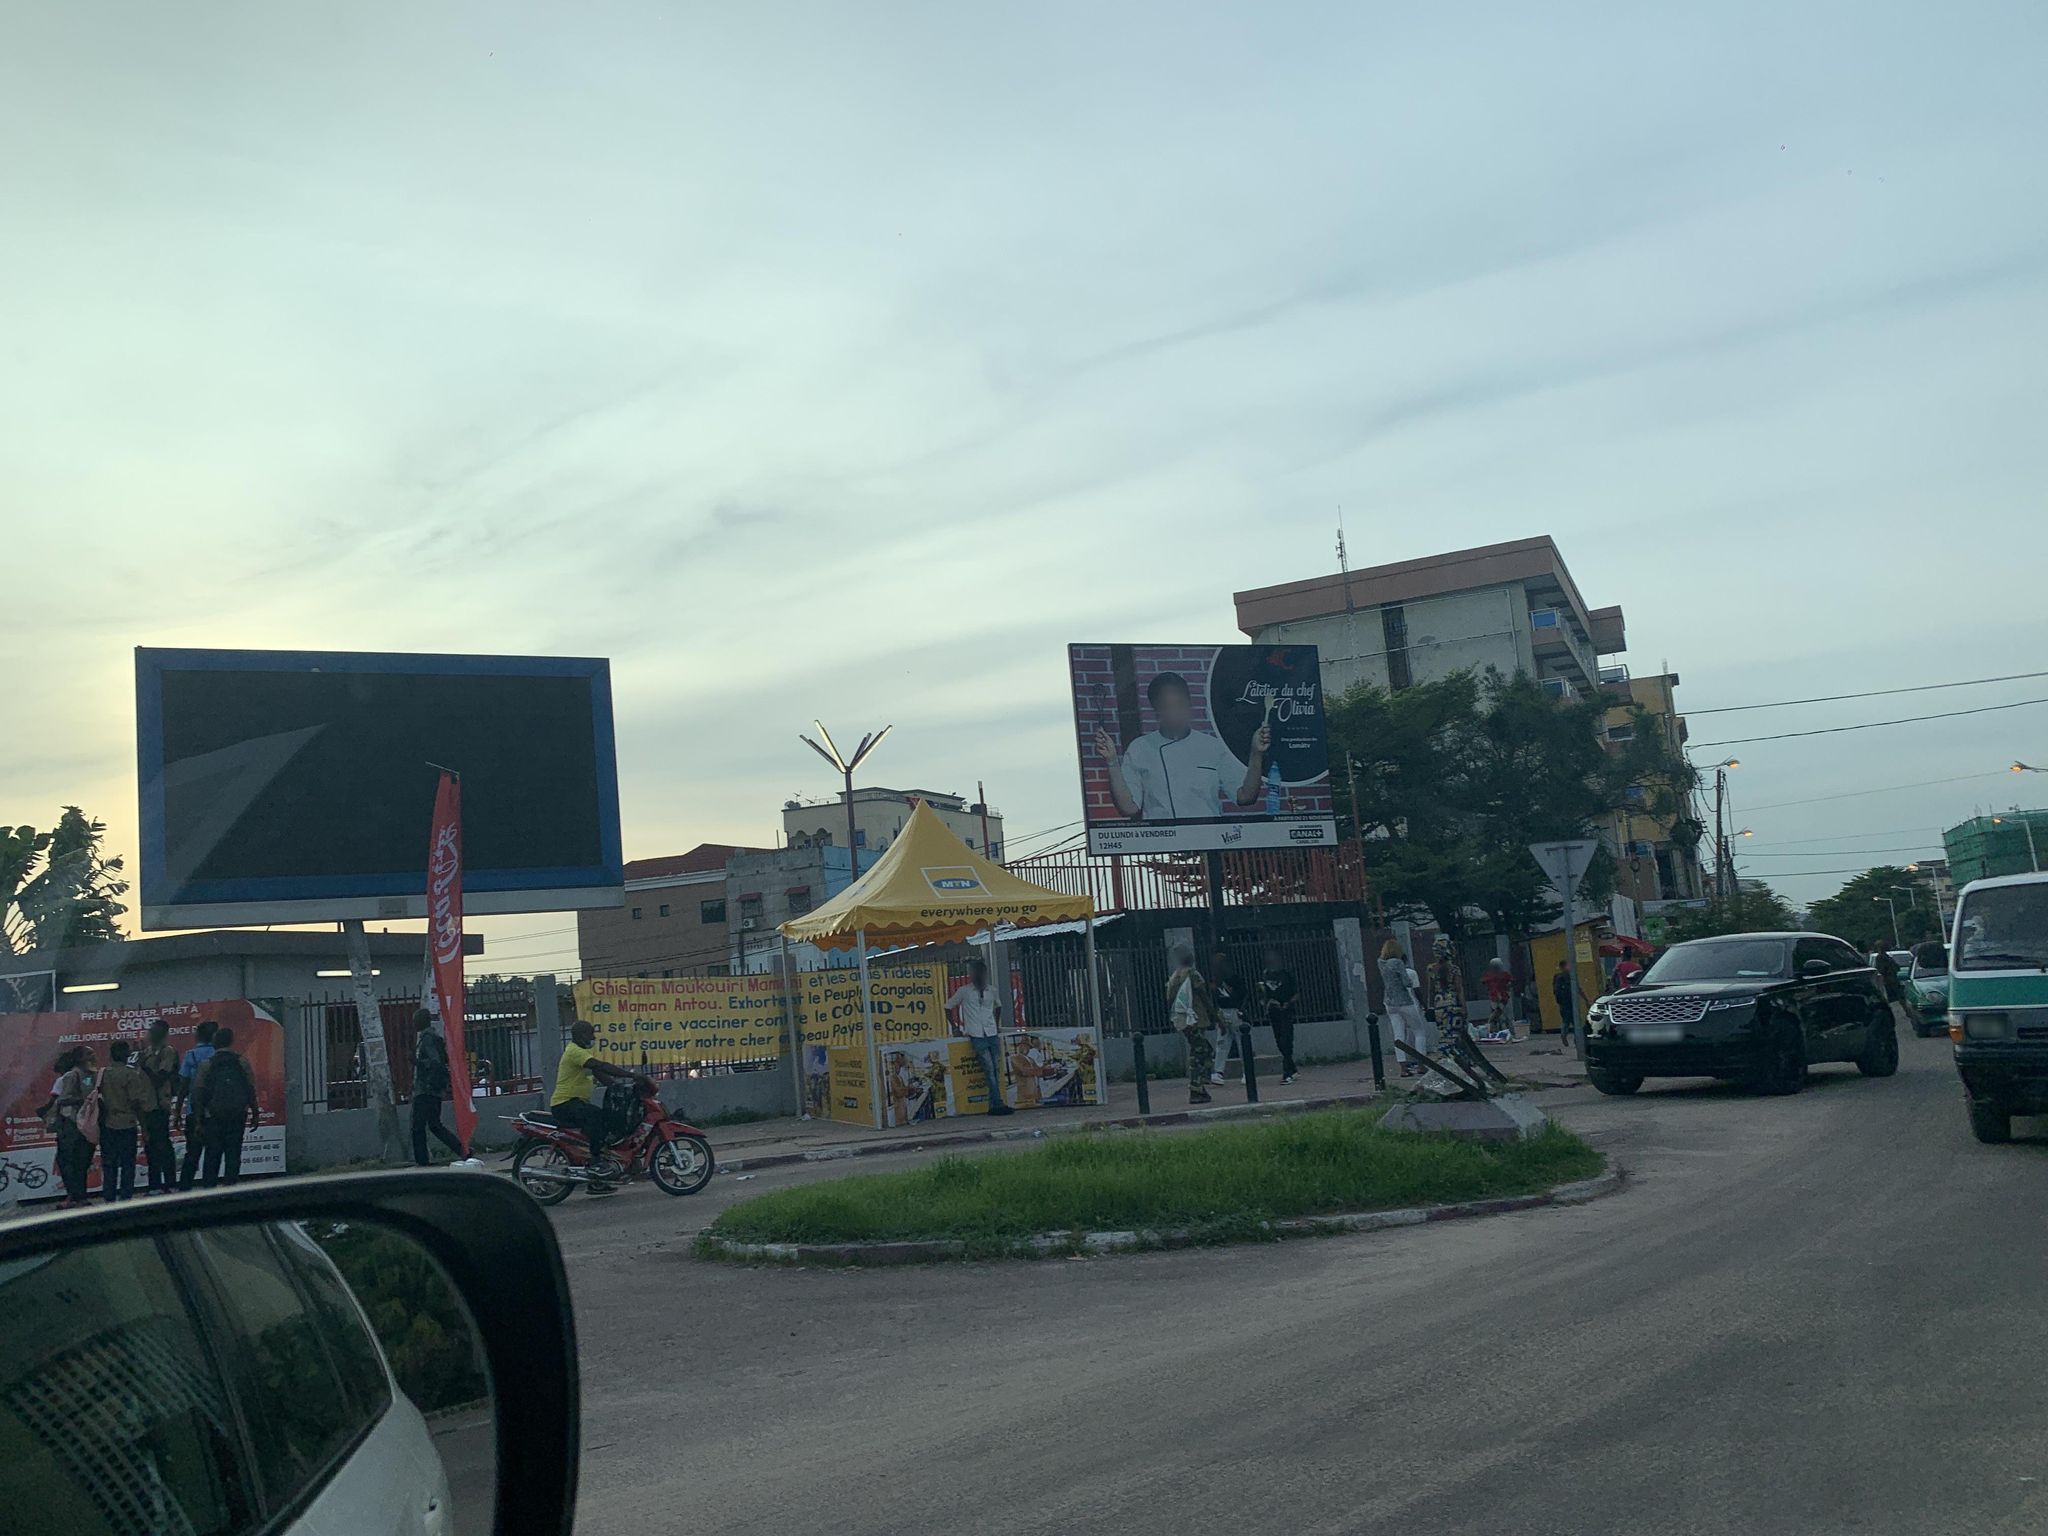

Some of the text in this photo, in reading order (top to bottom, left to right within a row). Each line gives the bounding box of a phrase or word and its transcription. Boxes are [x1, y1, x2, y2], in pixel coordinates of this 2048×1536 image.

[1281, 683, 1294, 697] du
[1296, 681, 1316, 701] chef
[1272, 697, 1316, 722] Olivia
[1098, 831, 1110, 840] DU
[1111, 831, 1133, 839] LUNDI
[1140, 829, 1177, 838] VENDREDI
[1290, 830, 1323, 838] CANAL+
[1099, 842, 1122, 850] 12H45
[941, 880, 971, 888] MTN
[921, 904, 1037, 918] everywhere you go
[592, 980, 656, 996] Ghislain
[661, 980, 744, 995] Moukouiri
[809, 974, 823, 988] et
[826, 971, 846, 986] les
[592, 1000, 611, 1013] de
[618, 999, 667, 1013] Maman
[674, 998, 722, 1012] Antou.
[809, 991, 821, 1005] le
[870, 982, 934, 998] Congolais
[80, 1009, 109, 1021] PRÊT
[161, 1005, 189, 1016] PRÊT
[608, 1022, 627, 1033] se
[634, 1017, 673, 1032] faire
[680, 1015, 749, 1031] vacciner
[815, 1009, 828, 1022] le
[110, 1030, 137, 1040] VOTRE
[599, 1038, 637, 1052] Pour
[640, 1037, 691, 1050] sauver
[695, 1033, 736, 1049] notre
[739, 1031, 774, 1047] cher
[832, 1020, 864, 1038] Pays
[885, 1018, 933, 1036] Congo.
